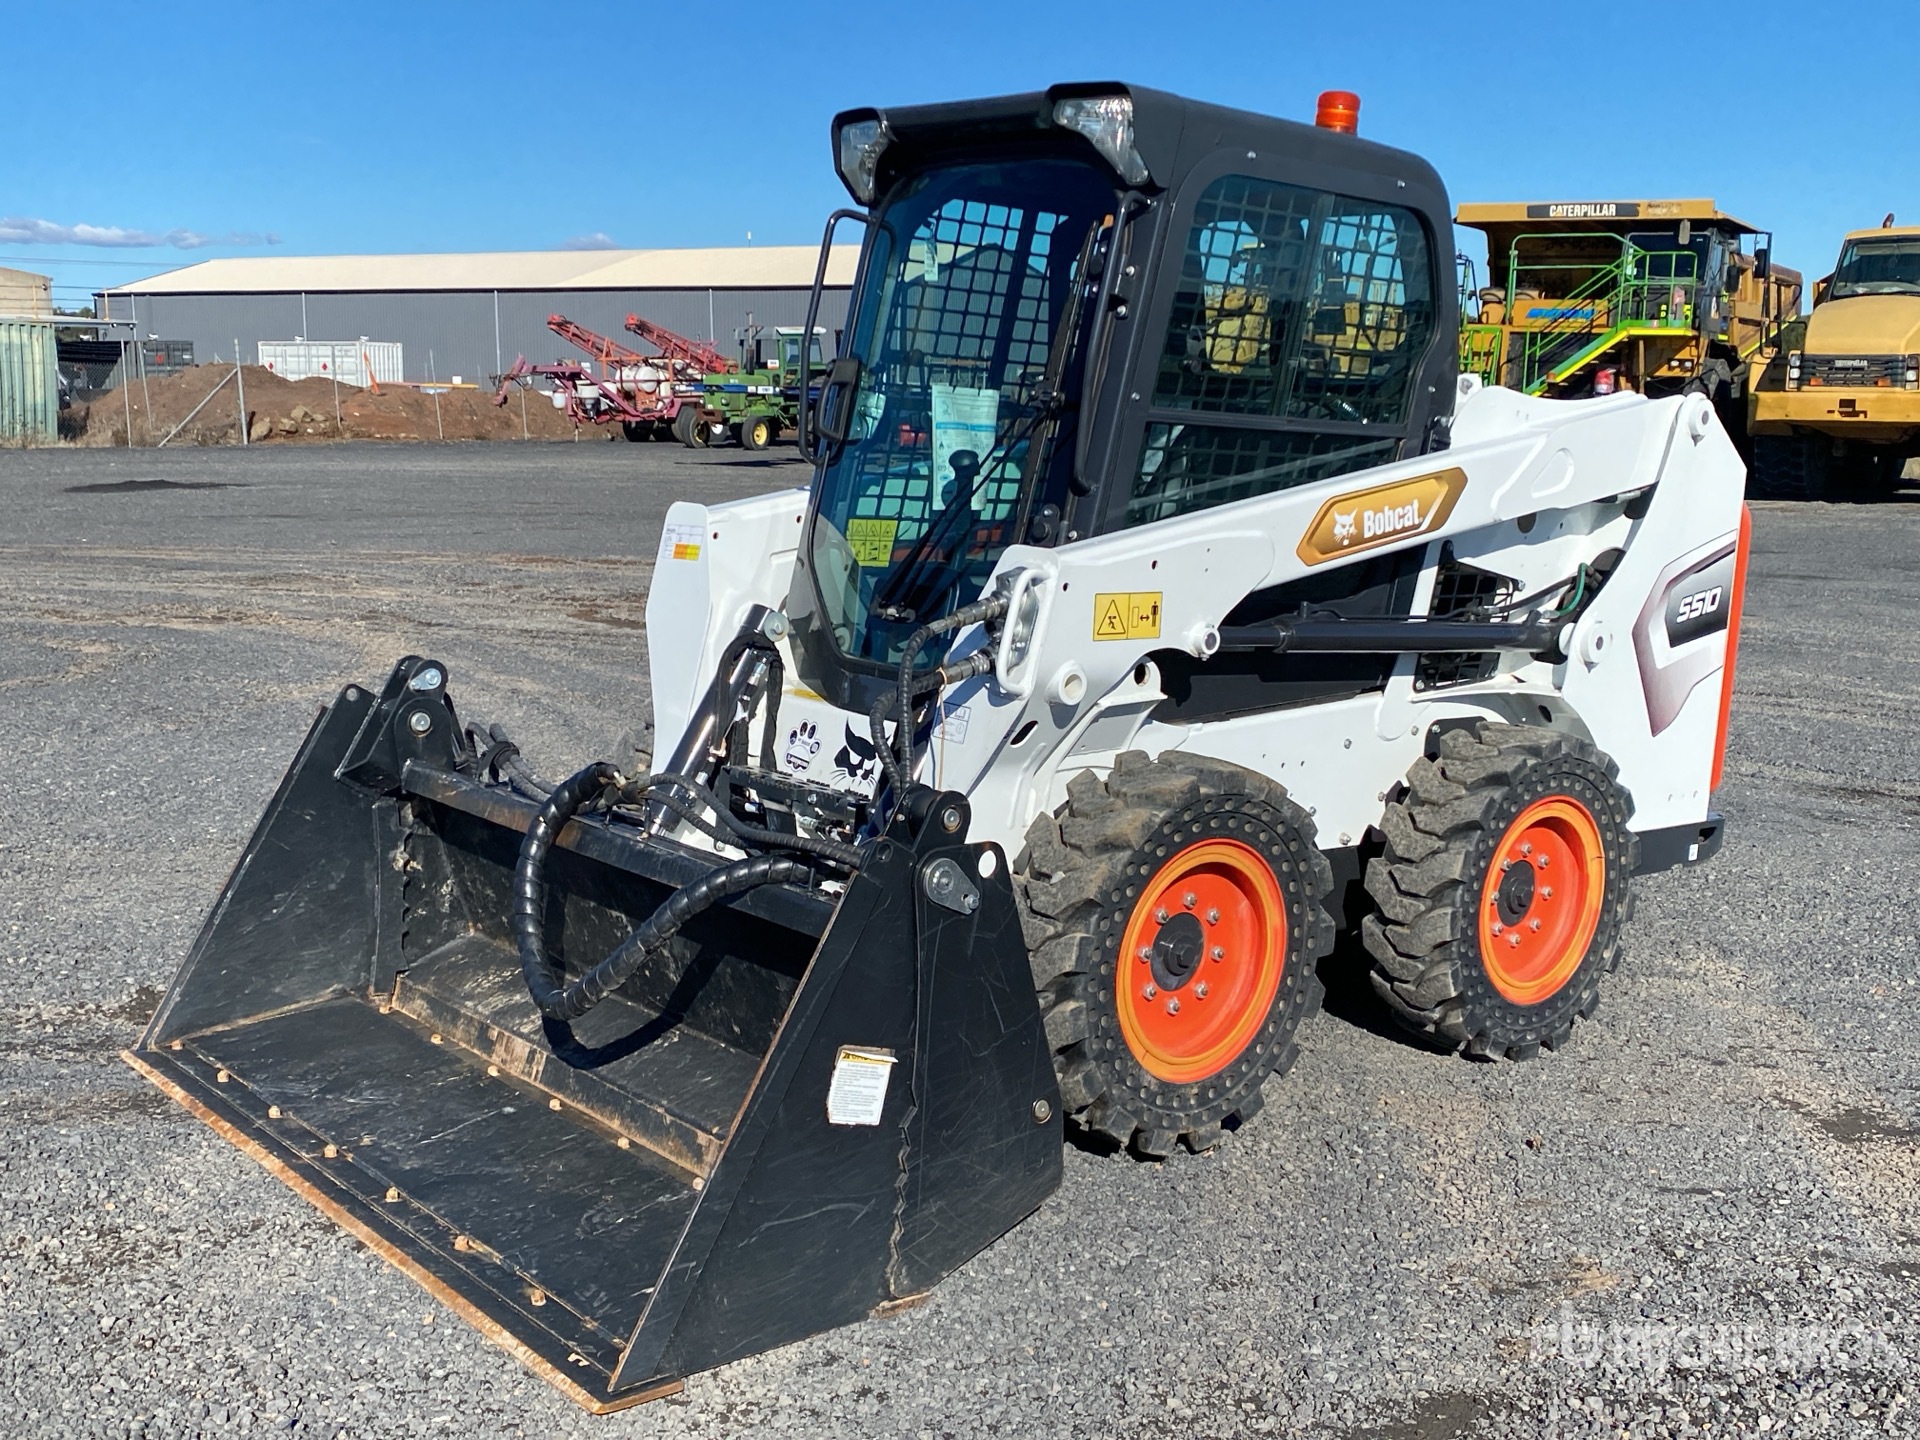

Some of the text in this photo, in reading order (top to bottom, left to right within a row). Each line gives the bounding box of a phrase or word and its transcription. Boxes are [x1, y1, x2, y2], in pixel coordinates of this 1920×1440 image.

[1549, 203, 1616, 217] CATERPILLAR
[1363, 499, 1420, 539] Bobcat
[1676, 586, 1723, 623] S510
